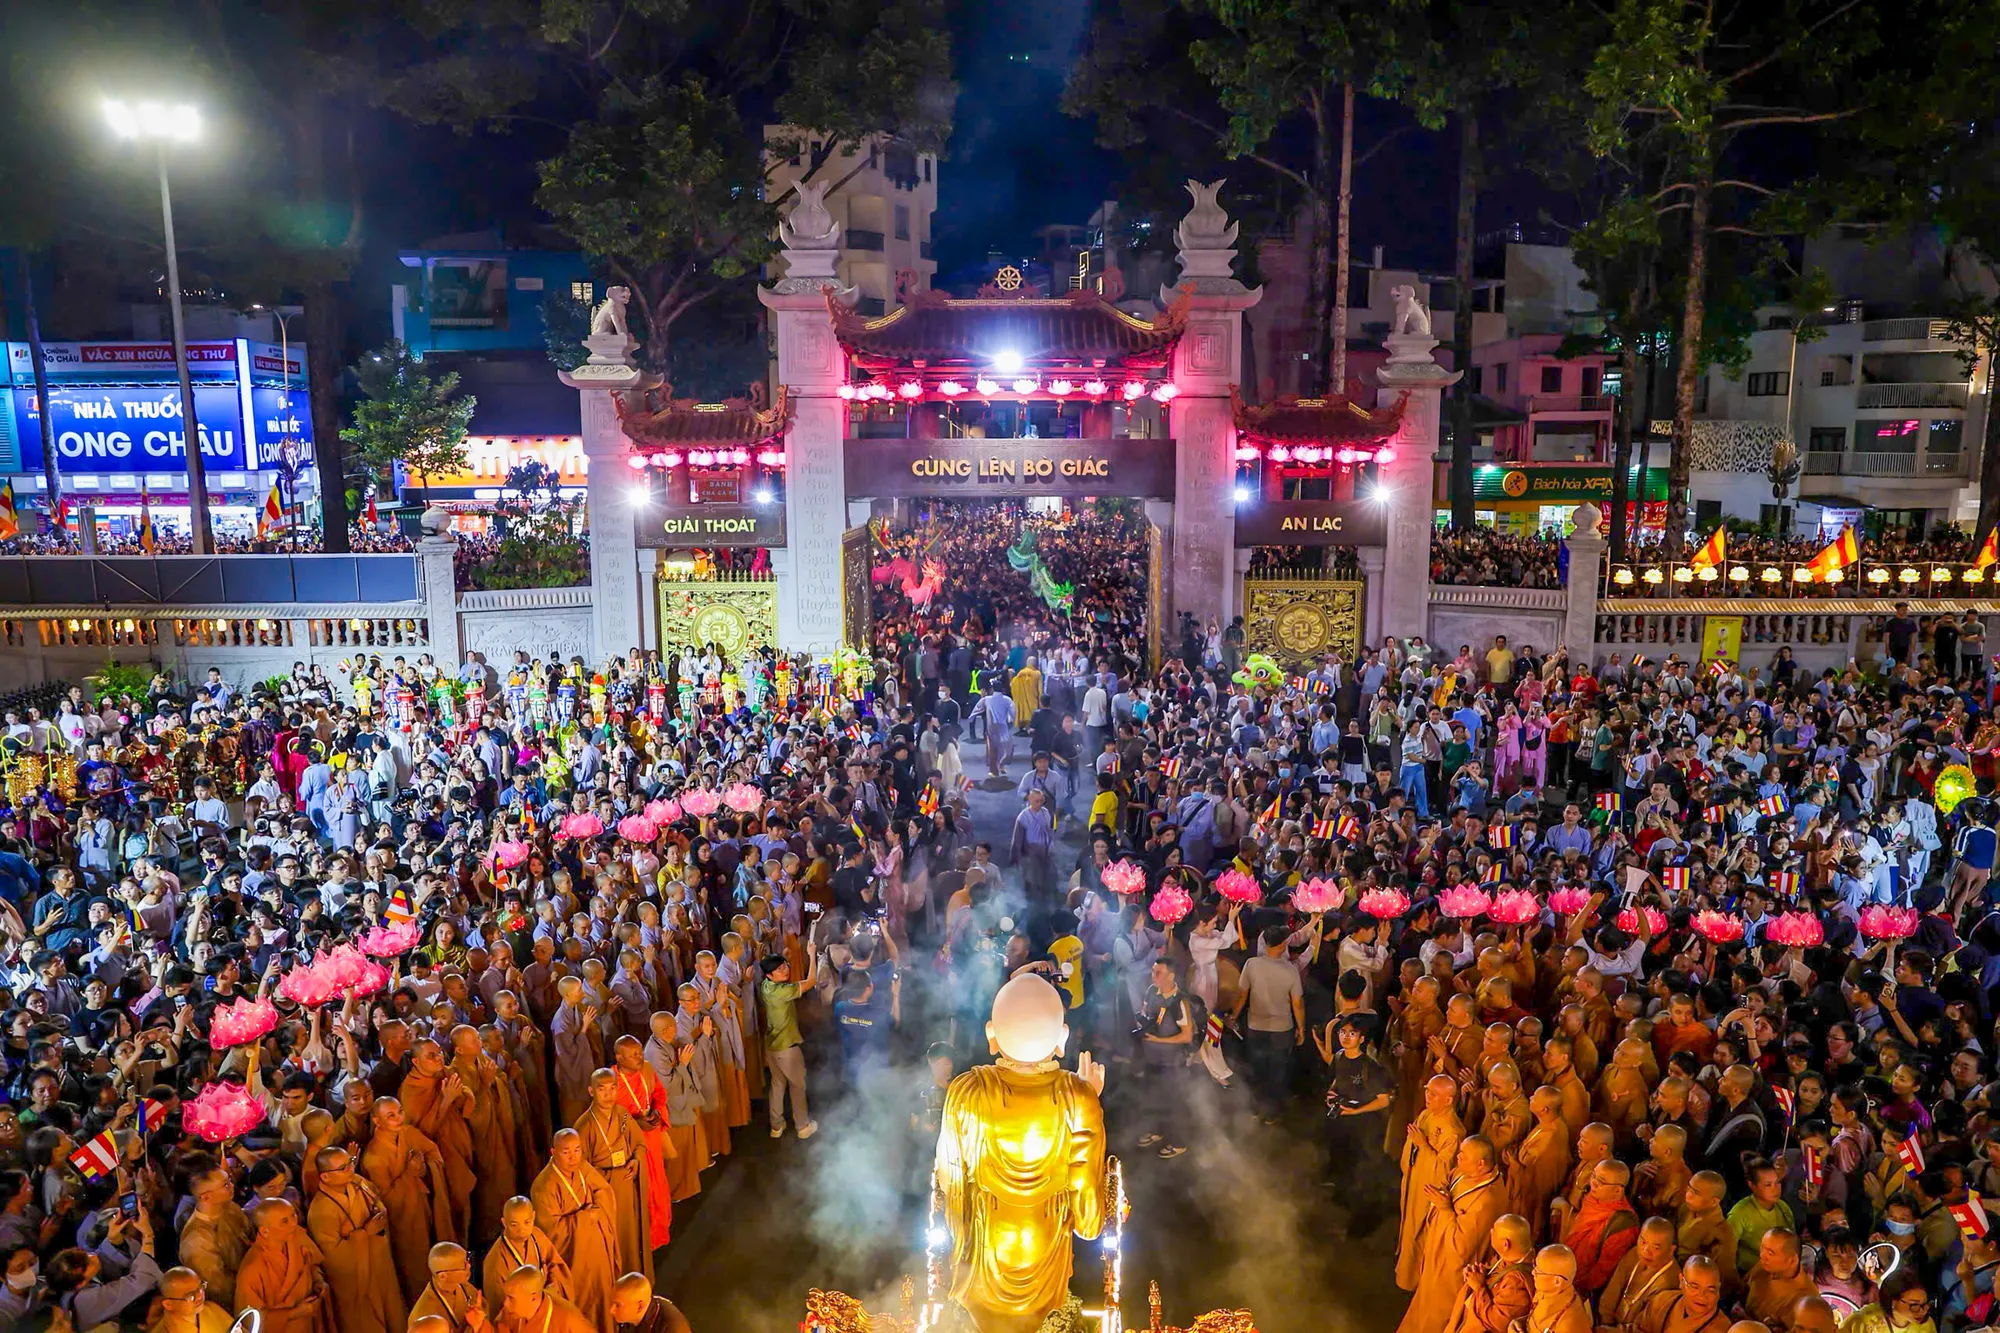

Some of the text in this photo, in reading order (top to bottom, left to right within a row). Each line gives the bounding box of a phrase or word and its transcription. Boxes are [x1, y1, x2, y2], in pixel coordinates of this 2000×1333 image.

[115, 350, 134, 360] XIN
[185, 350, 199, 359] NG
[202, 348, 227, 359] THƯ
[74, 396, 117, 420] NHÀ
[56, 431, 132, 457] ONG
[911, 455, 1109, 477] CÙNG LÊN BỜ GIÁC
[1533, 477, 1613, 490] Bách hóa XAN
[664, 515, 757, 533] GIẢI THOÁT
[1281, 517, 1342, 534] AN LẠC
